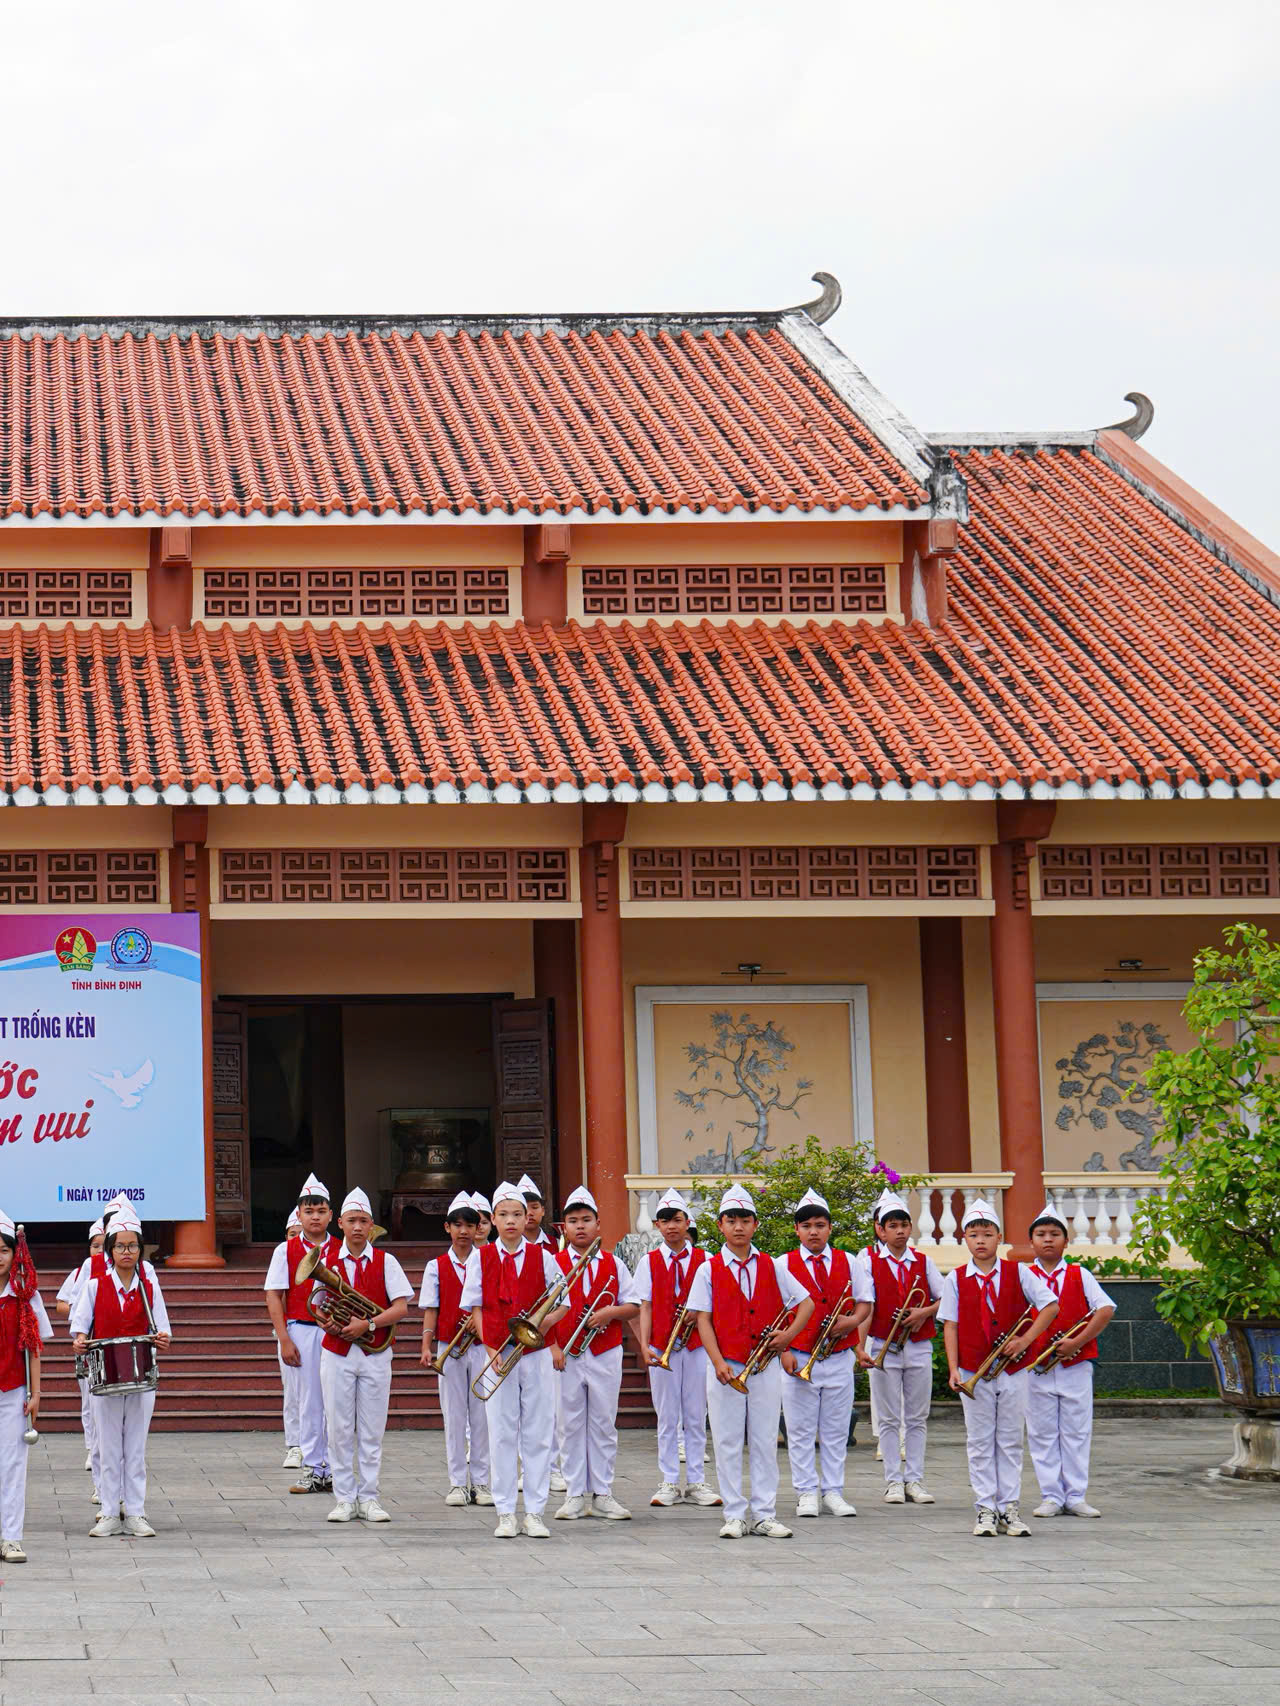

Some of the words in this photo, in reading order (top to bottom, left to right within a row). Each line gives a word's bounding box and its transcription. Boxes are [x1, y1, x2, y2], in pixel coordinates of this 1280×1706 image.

[72, 978, 92, 991] TỈNH
[95, 978, 116, 990] BÌNH
[118, 980, 142, 993] ĐỊNH
[12, 1009, 61, 1039] TRỐNG
[65, 1012, 96, 1038] KÈN
[32, 1099, 95, 1144] vui
[66, 1185, 94, 1202] NGÀY
